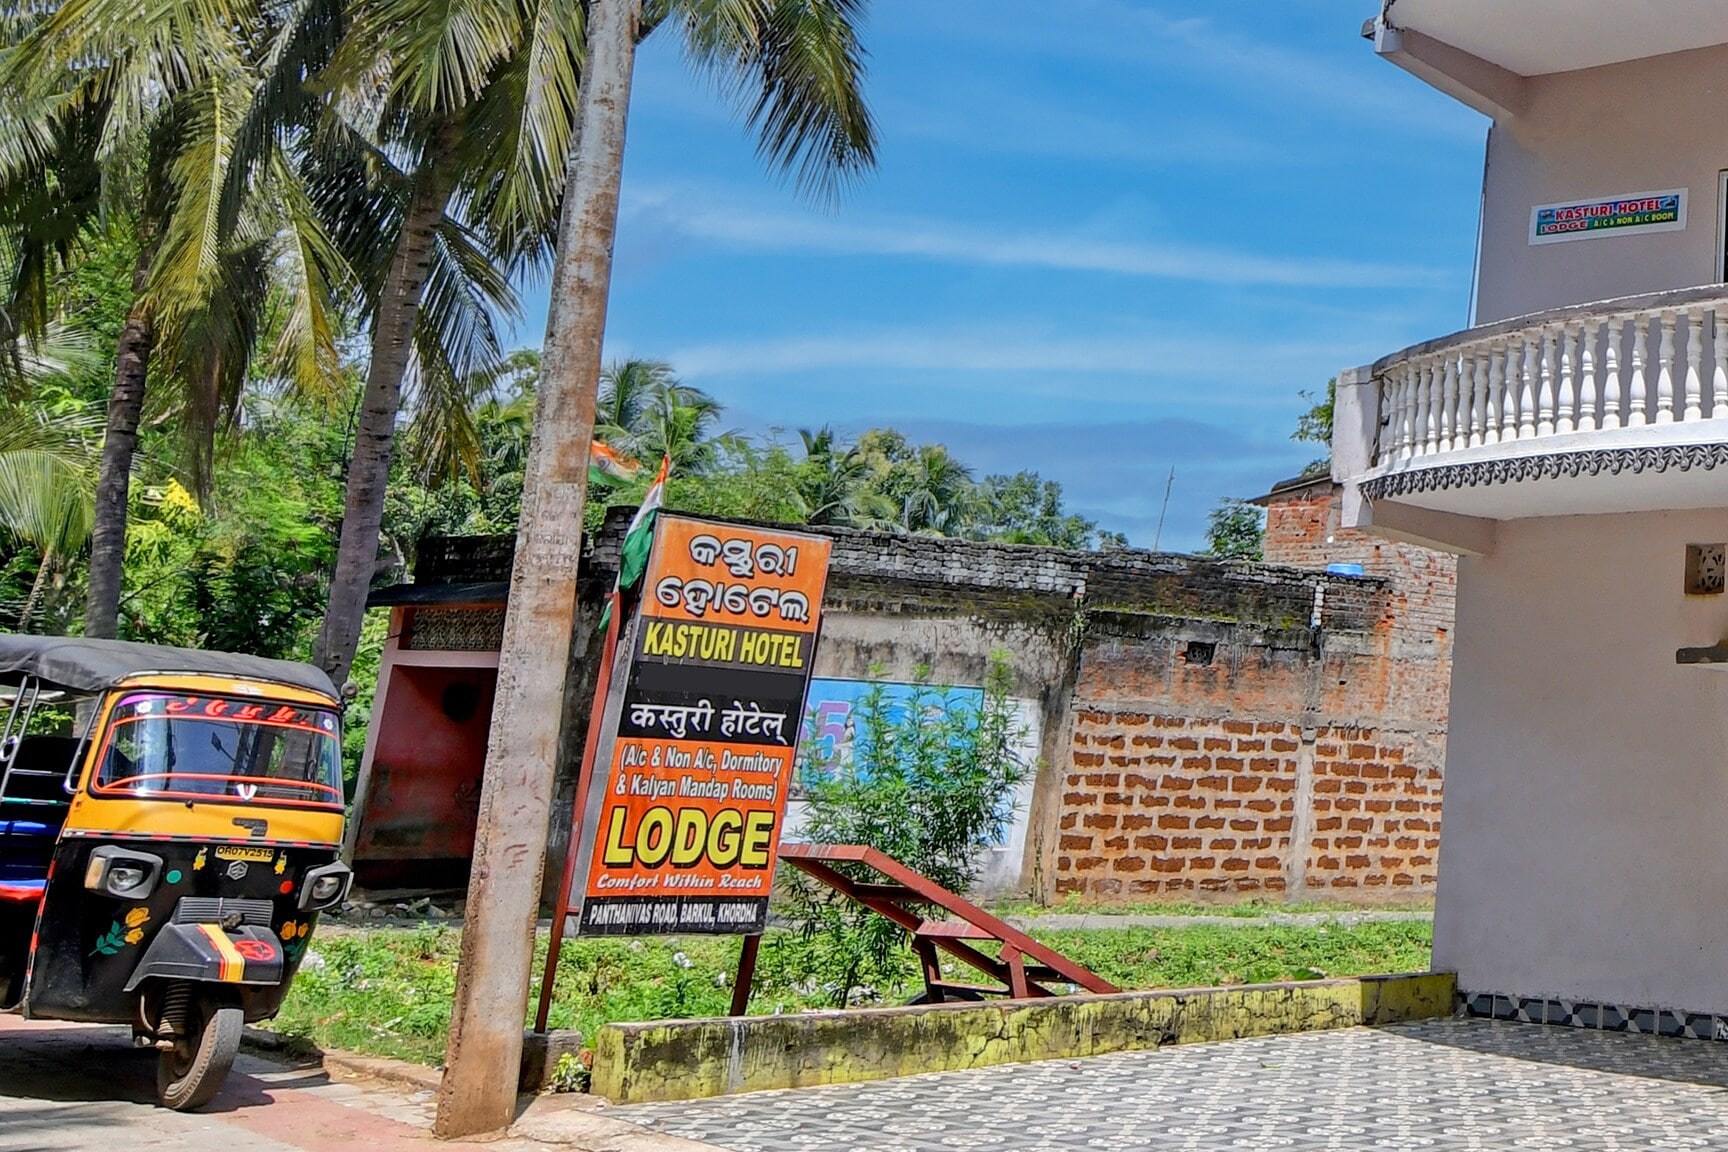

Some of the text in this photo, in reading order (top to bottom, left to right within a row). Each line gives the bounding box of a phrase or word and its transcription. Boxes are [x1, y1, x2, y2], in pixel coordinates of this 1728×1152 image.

[1541, 220, 1588, 234] LODGE
[1616, 216, 1633, 225] NON
[1651, 211, 1674, 221] ROOM
[1555, 199, 1661, 221] KASTURI HOTEL
[656, 576, 809, 622] ହୋଟେଲ
[643, 621, 803, 666] KASTURI HOTEL
[630, 699, 715, 738] कस्तुरी
[620, 744, 783, 778] (A/c & Non A/c, Dormitory
[616, 774, 779, 805] & Kalyan Mandap Rooms)
[603, 806, 775, 866] LODGE
[597, 873, 762, 891] Comfort Within Reach
[589, 903, 758, 927] PANTHANIVAS ROAD, BARKUL, KHORDHA
